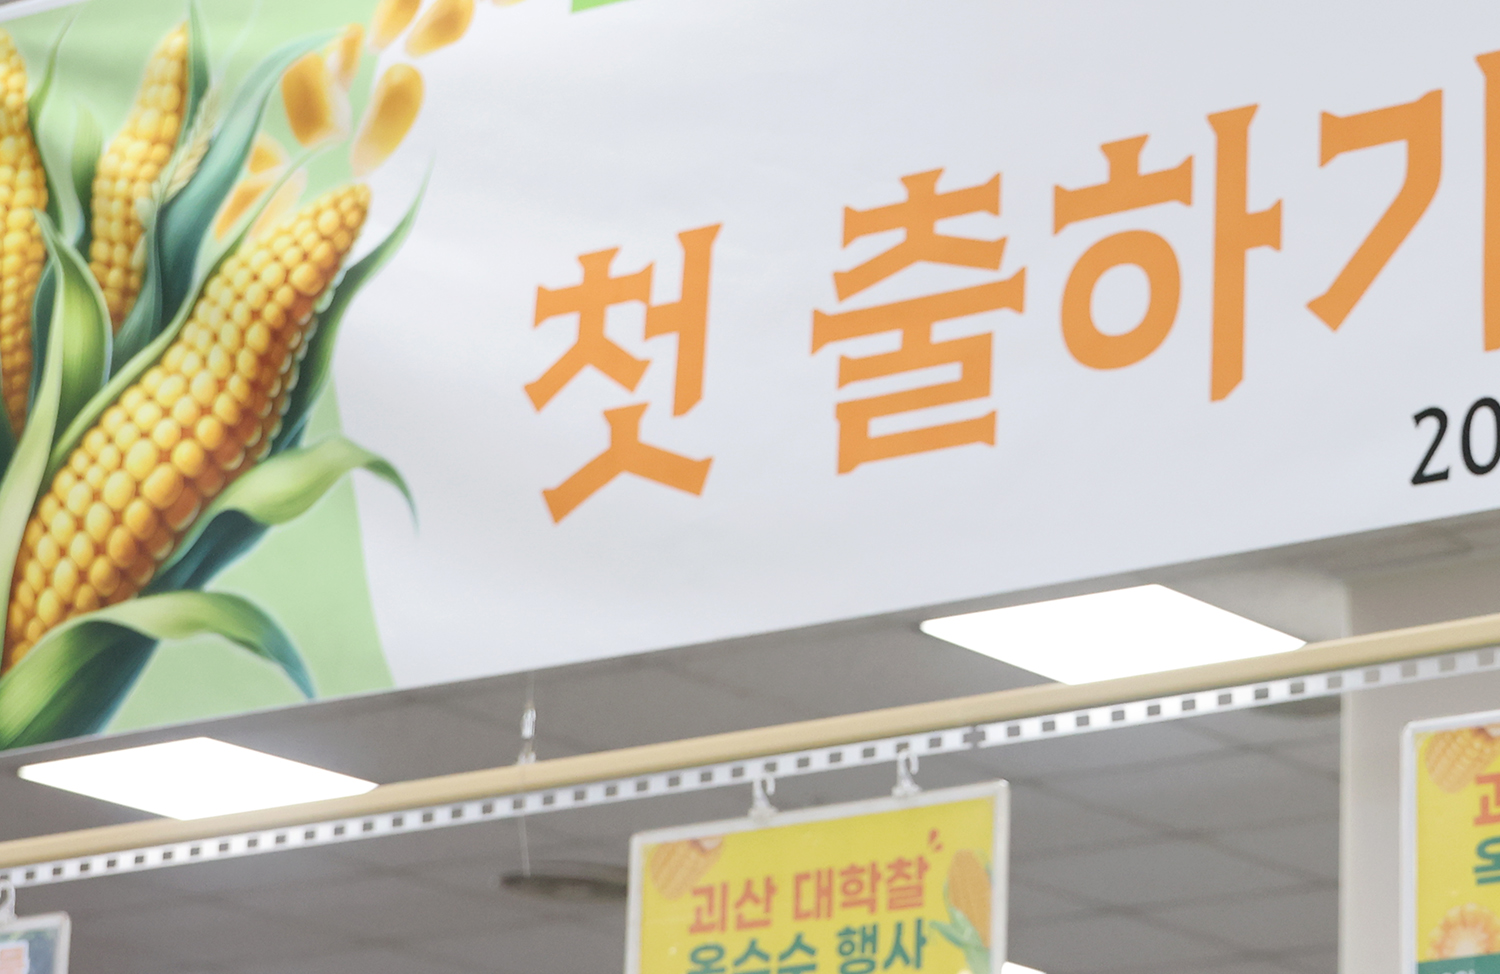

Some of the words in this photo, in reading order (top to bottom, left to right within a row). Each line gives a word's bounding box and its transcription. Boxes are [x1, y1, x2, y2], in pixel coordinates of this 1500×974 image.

[522, 222, 724, 525] 첫
[688, 875, 777, 936] 괴산
[792, 855, 930, 922] 대학찰
